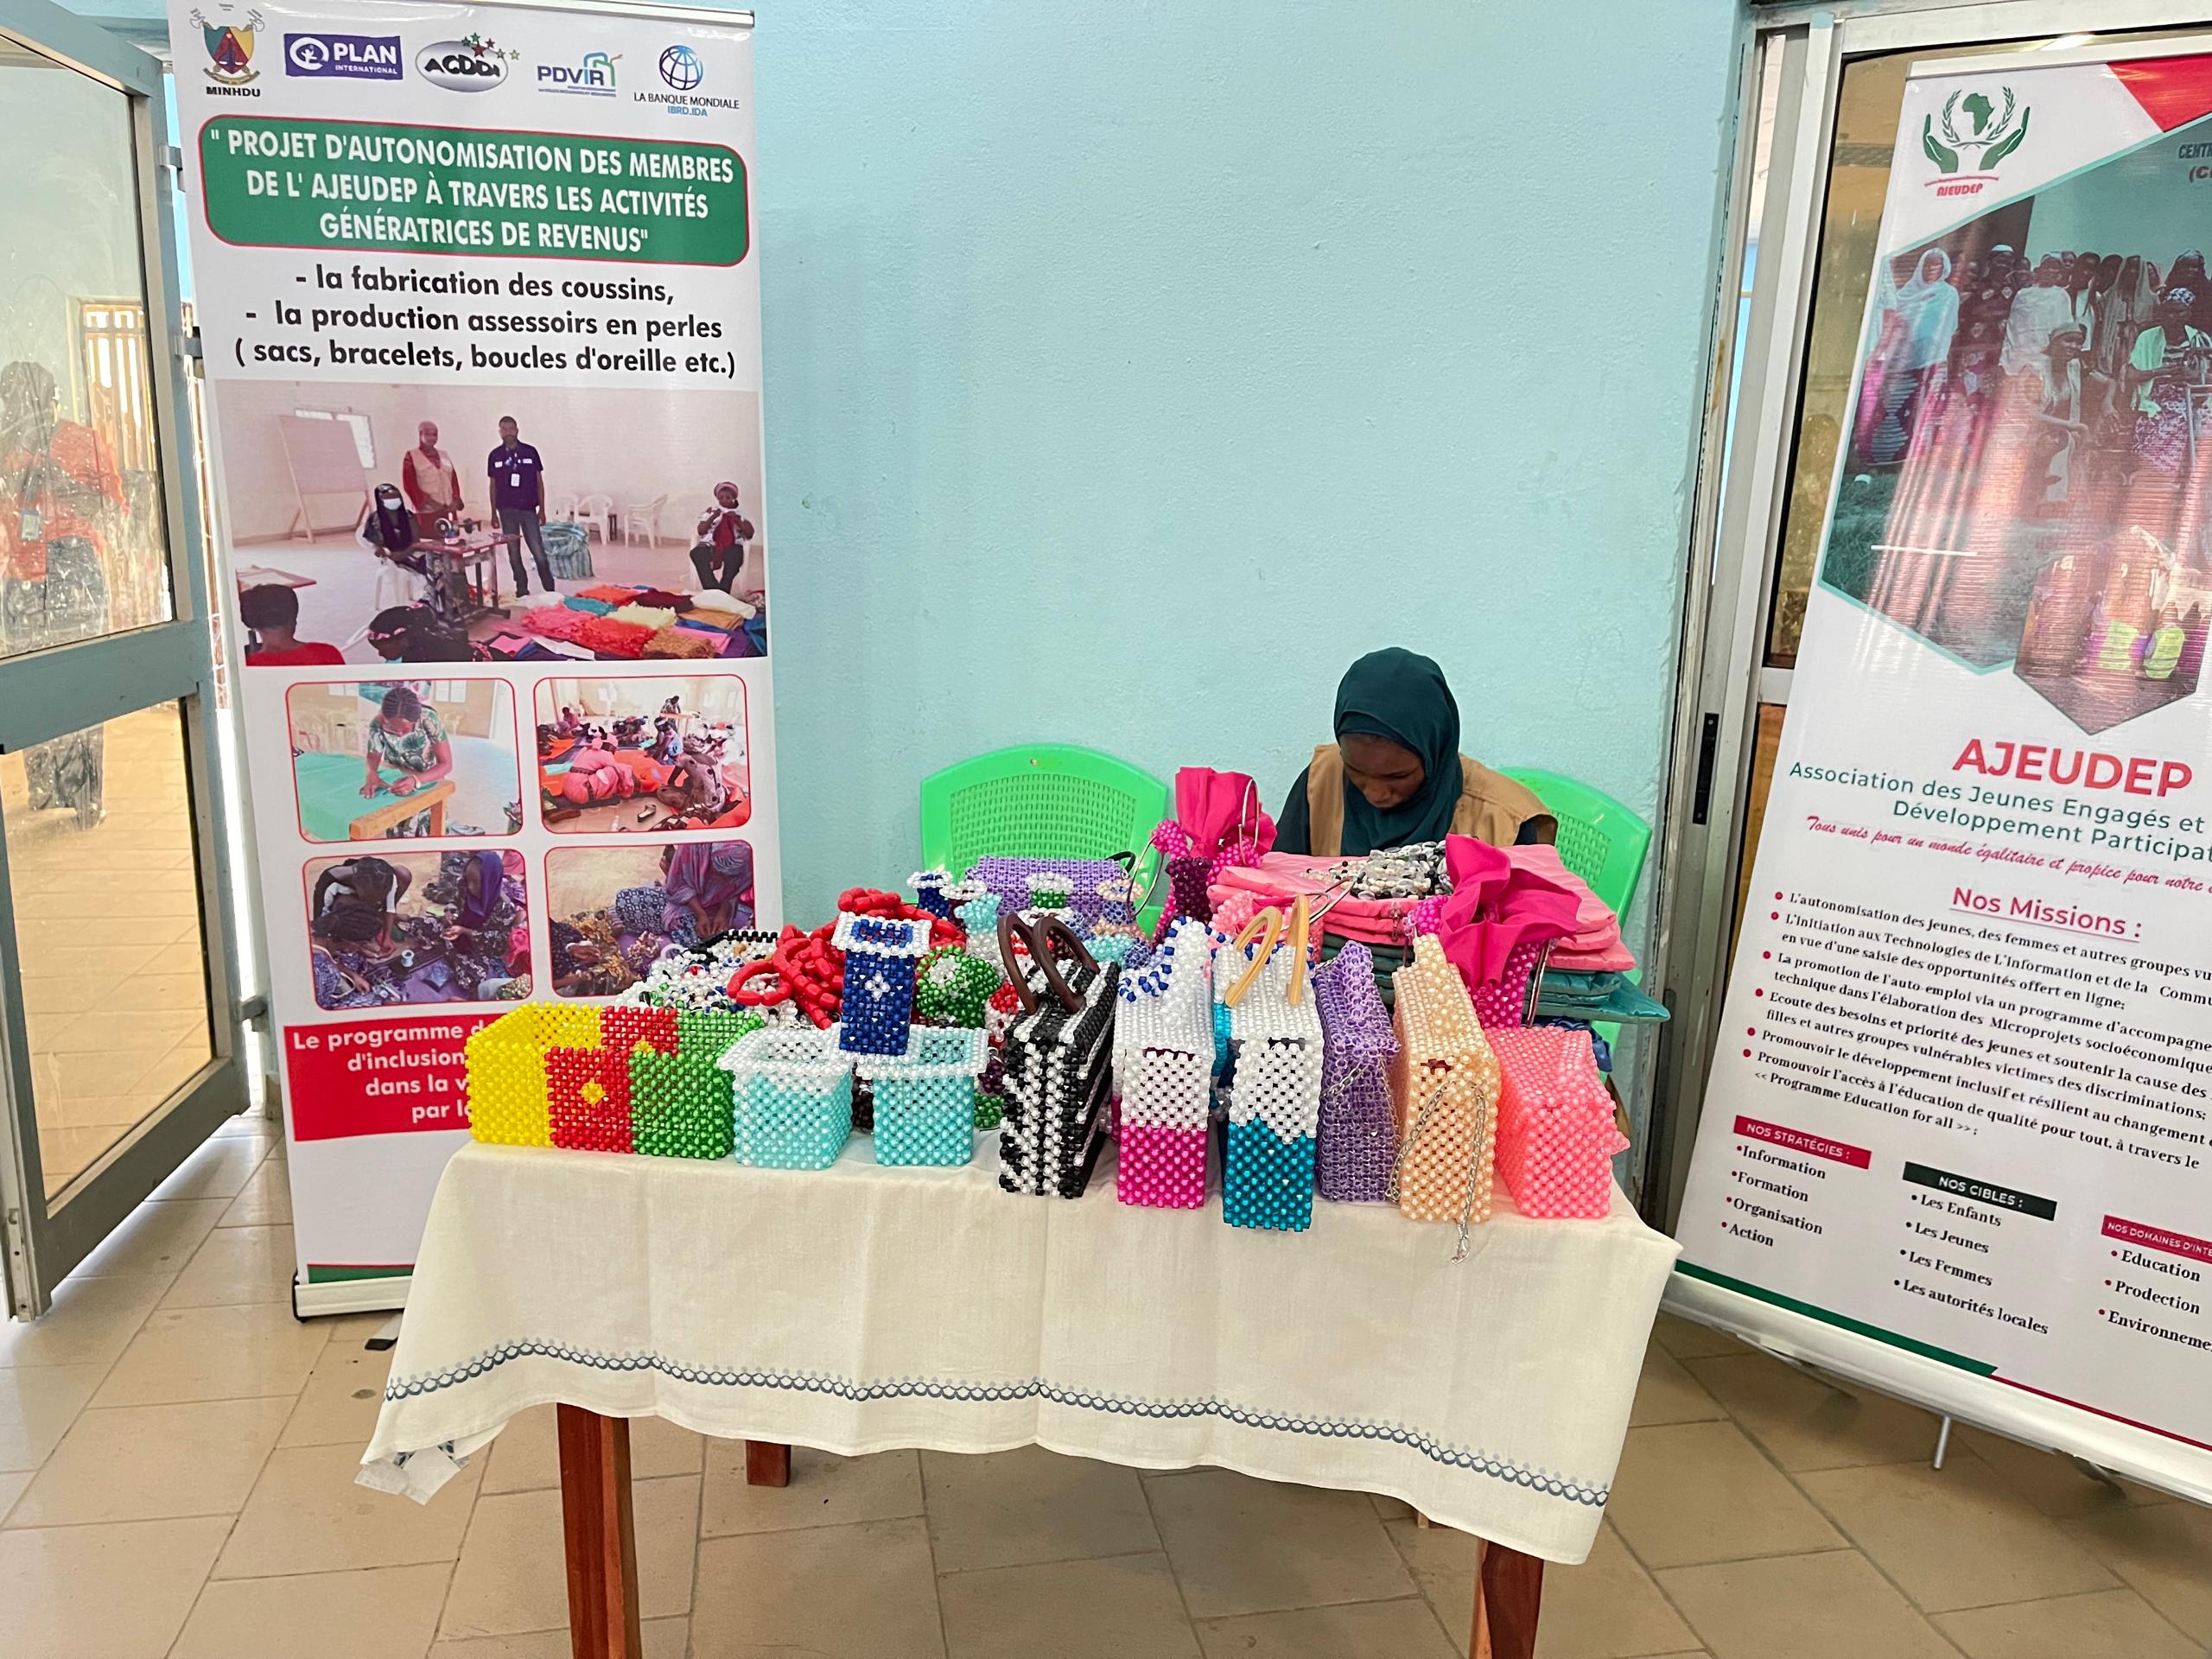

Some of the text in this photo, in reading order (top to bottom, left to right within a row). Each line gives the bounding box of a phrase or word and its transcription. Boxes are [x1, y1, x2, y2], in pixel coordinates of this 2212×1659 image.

[333, 42, 397, 65] PLAN
[334, 64, 398, 75] INTERNATIONAL
[206, 86, 261, 98] MINHDU
[633, 92, 741, 110] LA BANQUE MONDIALE
[227, 129, 734, 183] PROJET D'AUTONOMISATION DES MEMBRES
[246, 169, 279, 196] DE
[311, 173, 417, 203] AJEUDEP
[425, 171, 443, 205] À
[448, 181, 549, 210] TRAVERS
[556, 185, 593, 213] LES
[600, 186, 709, 219] ACTIVITÉS
[320, 206, 494, 246] GÉNÉRATRICES
[500, 221, 531, 247] DE
[315, 263, 674, 306] la fabrication des coussins,
[275, 299, 722, 343] la production assessoirs en perles
[253, 339, 735, 380] sacs, bracelets, boucles d'oreille etc.)
[1951, 738, 2193, 798] AJEUDEP
[1789, 761, 2205, 834] Association des Jeunes Engagés et
[1893, 799, 2083, 843] Développement
[1806, 815, 1837, 834] Tous
[1840, 827, 1868, 839] unis
[1870, 830, 1904, 844] pour
[1906, 837, 1925, 848] un
[1928, 841, 1973, 855] monde
[1975, 842, 2045, 867] égalitaire
[2048, 857, 2065, 870] et
[2064, 860, 2122, 879] propice
[2122, 868, 2159, 885] pour
[2164, 877, 2204, 892] notre
[1952, 887, 2126, 935] Nos Missions
[1789, 893, 1900, 923] L'autonomisation
[1902, 913, 1925, 928] des
[1978, 927, 2002, 942] des
[2005, 932, 2060, 952] femmes
[2080, 949, 2127, 965] autres
[2130, 958, 2190, 977] groupes
[1857, 930, 1881, 942] aux
[1884, 932, 1972, 959] Technologies
[1800, 937, 2062, 996] vue d'une saisie des opportunités offert
[1774, 971, 1837, 993] technique
[1839, 983, 1869, 1000] dans
[1871, 990, 1957, 1020] l'élaboration
[1960, 1010, 1985, 1025] des
[1989, 1016, 2082, 1046] Microprojets
[1794, 958, 1860, 979] promotion
[1975, 995, 1994, 1007] via
[2018, 1005, 2103, 1030] programme
[293, 1031, 321, 1051] Le
[327, 1023, 464, 1052] programme
[1769, 991, 1813, 1010] Ecoute
[1815, 1001, 1836, 1015] des
[1838, 1005, 1887, 1027] besoins
[1904, 1023, 1959, 1043] priorité
[1961, 1033, 1985, 1049] des
[2053, 1057, 2116, 1078] soutenir
[2135, 1075, 2178, 1092] cause
[2181, 1082, 2208, 1098] des
[1814, 1022, 1854, 1039] autres
[1856, 1032, 1910, 1052] groupes
[1913, 1045, 1992, 1071] vulnérables
[1995, 1063, 2055, 1084] victimes
[2057, 1076, 2082, 1091] des
[347, 1048, 465, 1071] d'inclusion
[365, 1077, 421, 1096] dans
[427, 1073, 448, 1092] la
[1762, 1029, 1836, 1056] Promouvoir
[1837, 1046, 1850, 1059] le
[1852, 1052, 1952, 1084] développement
[1955, 1075, 2012, 1098] inclusif
[2011, 1092, 2024, 1102] et
[2028, 1095, 2089, 1118] résilient
[2092, 1111, 2110, 1123] au
[2113, 1115, 2206, 1146] changement
[1770, 1071, 1954, 1129] Programme Education for all
[411, 1104, 450, 1124] par
[1757, 1051, 1832, 1078] Promouvoir
[1832, 1068, 1876, 1090] l'accès
[1888, 1082, 1964, 1112] l'éducation
[1967, 1103, 1985, 1116] de
[1986, 1110, 2038, 1130] qualité
[2040, 1123, 2076, 1139] pour
[2128, 1143, 2183, 1166] travers
[2184, 1154, 2200, 1169] le
[1746, 1123, 1772, 1137] NOS
[1742, 1145, 1826, 1179] Information
[1738, 1172, 1808, 1203] Formation
[1938, 1176, 2016, 1205] NOS CIBLES
[1733, 1198, 1823, 1235] Organisation
[1920, 1193, 2002, 1227] Les Enfants
[1728, 1223, 1774, 1247] Action
[1914, 1222, 1989, 1254] Les Jeunes
[2129, 1228, 2181, 1248] DOMAINES
[1908, 1250, 1993, 1287] Les Femmes
[2120, 1249, 2201, 1282] Education
[1903, 1279, 2049, 1335] Les autorités locales
[2114, 1280, 2200, 1315] Prodection
